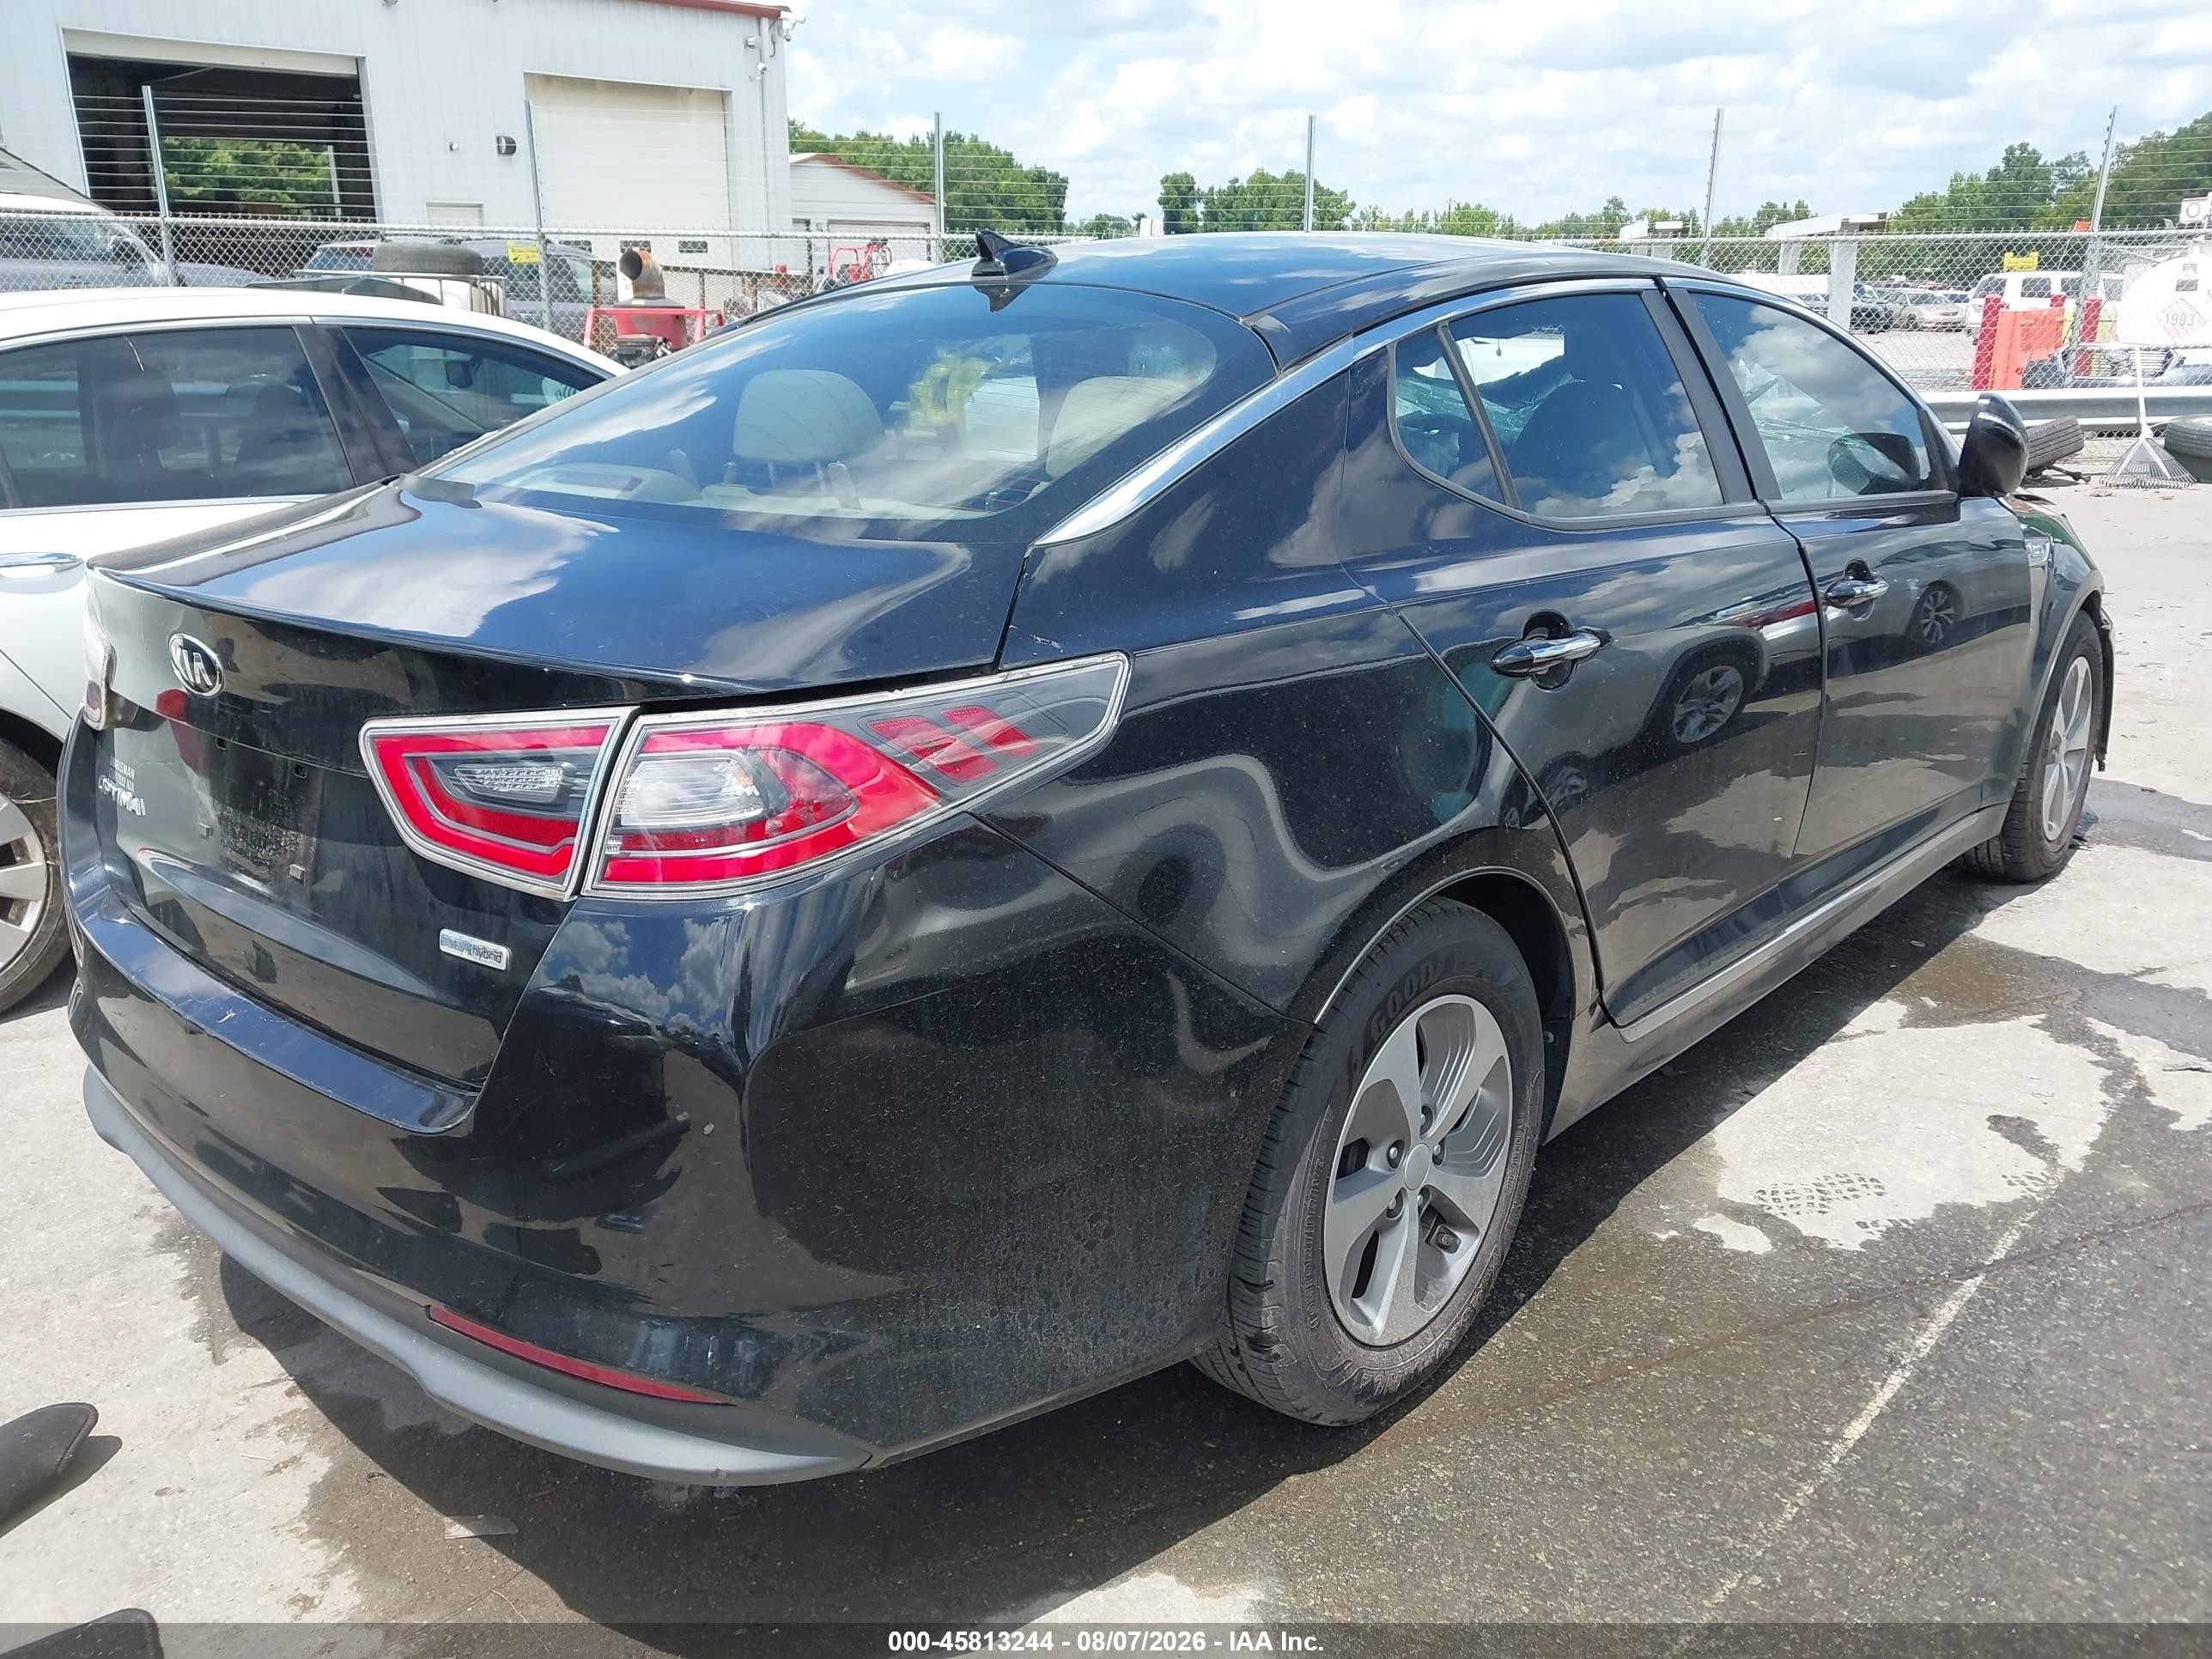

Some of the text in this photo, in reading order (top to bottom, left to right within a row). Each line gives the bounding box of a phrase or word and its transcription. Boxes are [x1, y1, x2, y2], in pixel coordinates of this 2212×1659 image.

[2165, 312, 2196, 326] 1993
[171, 639, 214, 686] KIA
[472, 945, 502, 963] hybrid
